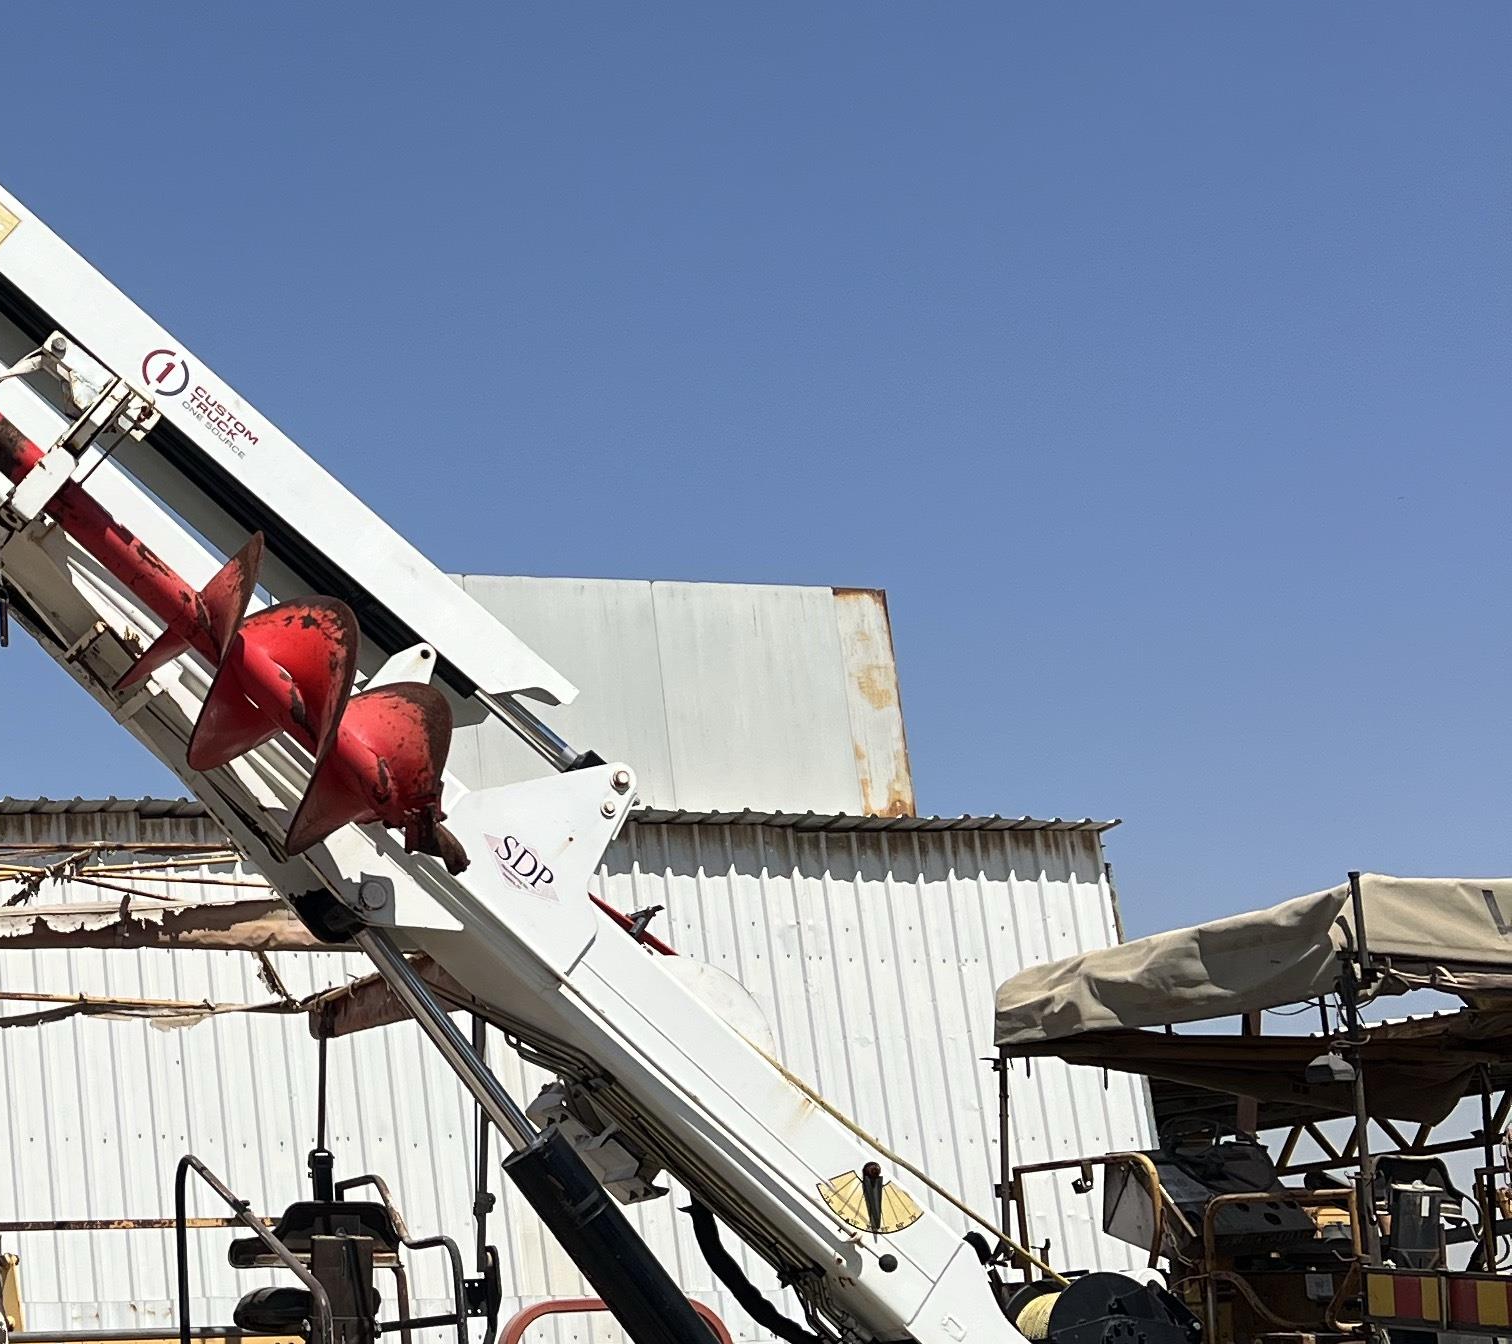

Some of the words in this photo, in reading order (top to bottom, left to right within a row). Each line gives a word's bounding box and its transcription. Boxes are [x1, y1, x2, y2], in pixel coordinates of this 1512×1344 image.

[181, 400, 204, 422] ONE
[204, 421, 247, 460] SOURCE
[190, 393, 240, 442] TRUCK
[194, 385, 260, 446] CUSTOM
[494, 835, 554, 888] SDP
